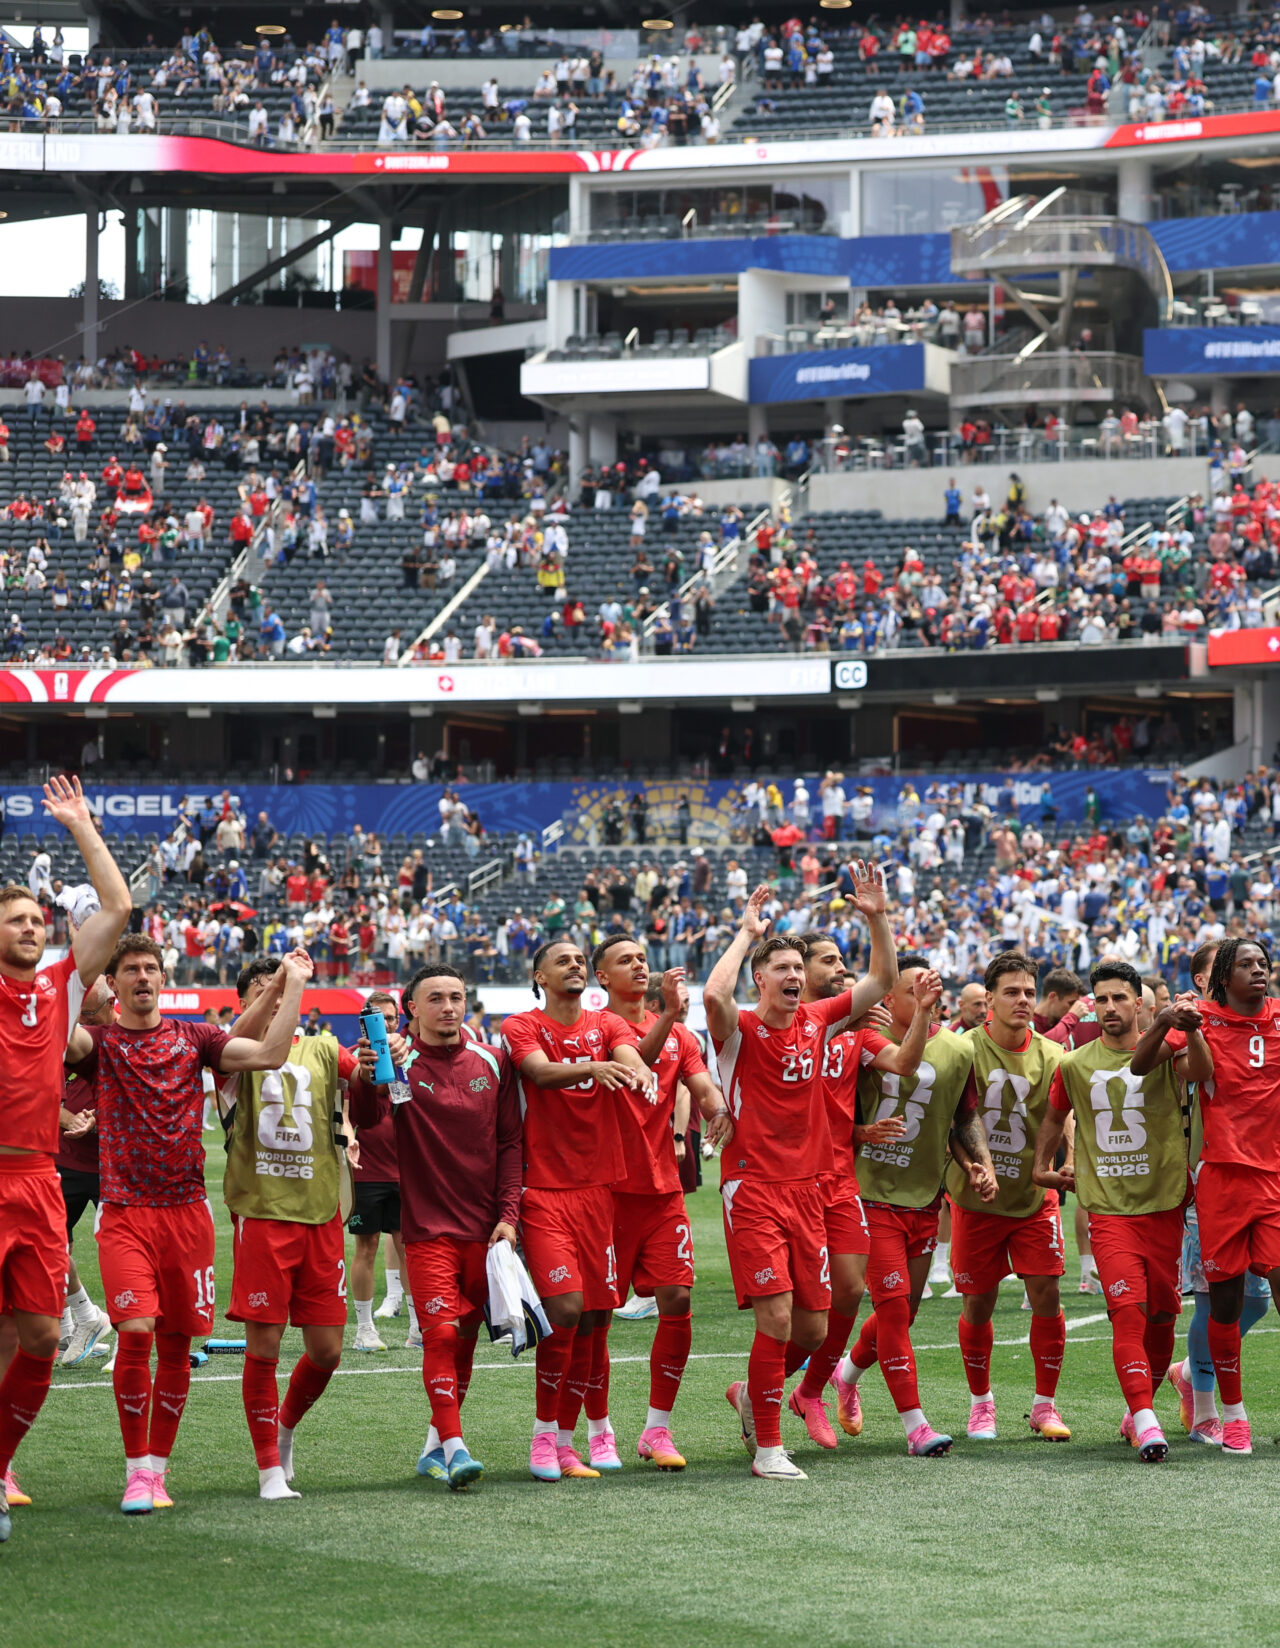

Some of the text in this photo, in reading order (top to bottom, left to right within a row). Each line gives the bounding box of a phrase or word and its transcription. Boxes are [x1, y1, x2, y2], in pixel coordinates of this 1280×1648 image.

[839, 666, 862, 684] CC
[20, 994, 37, 1027] 3
[1249, 1035, 1264, 1067] 9
[782, 1048, 814, 1081] 26
[821, 1044, 844, 1078] 13
[275, 1131, 301, 1142] FIFA
[989, 1134, 1011, 1145] FIFA
[1108, 1134, 1133, 1144] FIFA
[256, 1151, 314, 1164] WORLD CUP
[860, 1146, 911, 1168] 2026
[895, 1145, 914, 1155] CUP
[1004, 1156, 1022, 1165] CUP
[1096, 1153, 1149, 1164] WORLD CUP
[256, 1161, 314, 1180] 2026
[994, 1164, 1020, 1179] 26
[1096, 1163, 1150, 1177] 2026
[193, 1265, 215, 1308] 16
